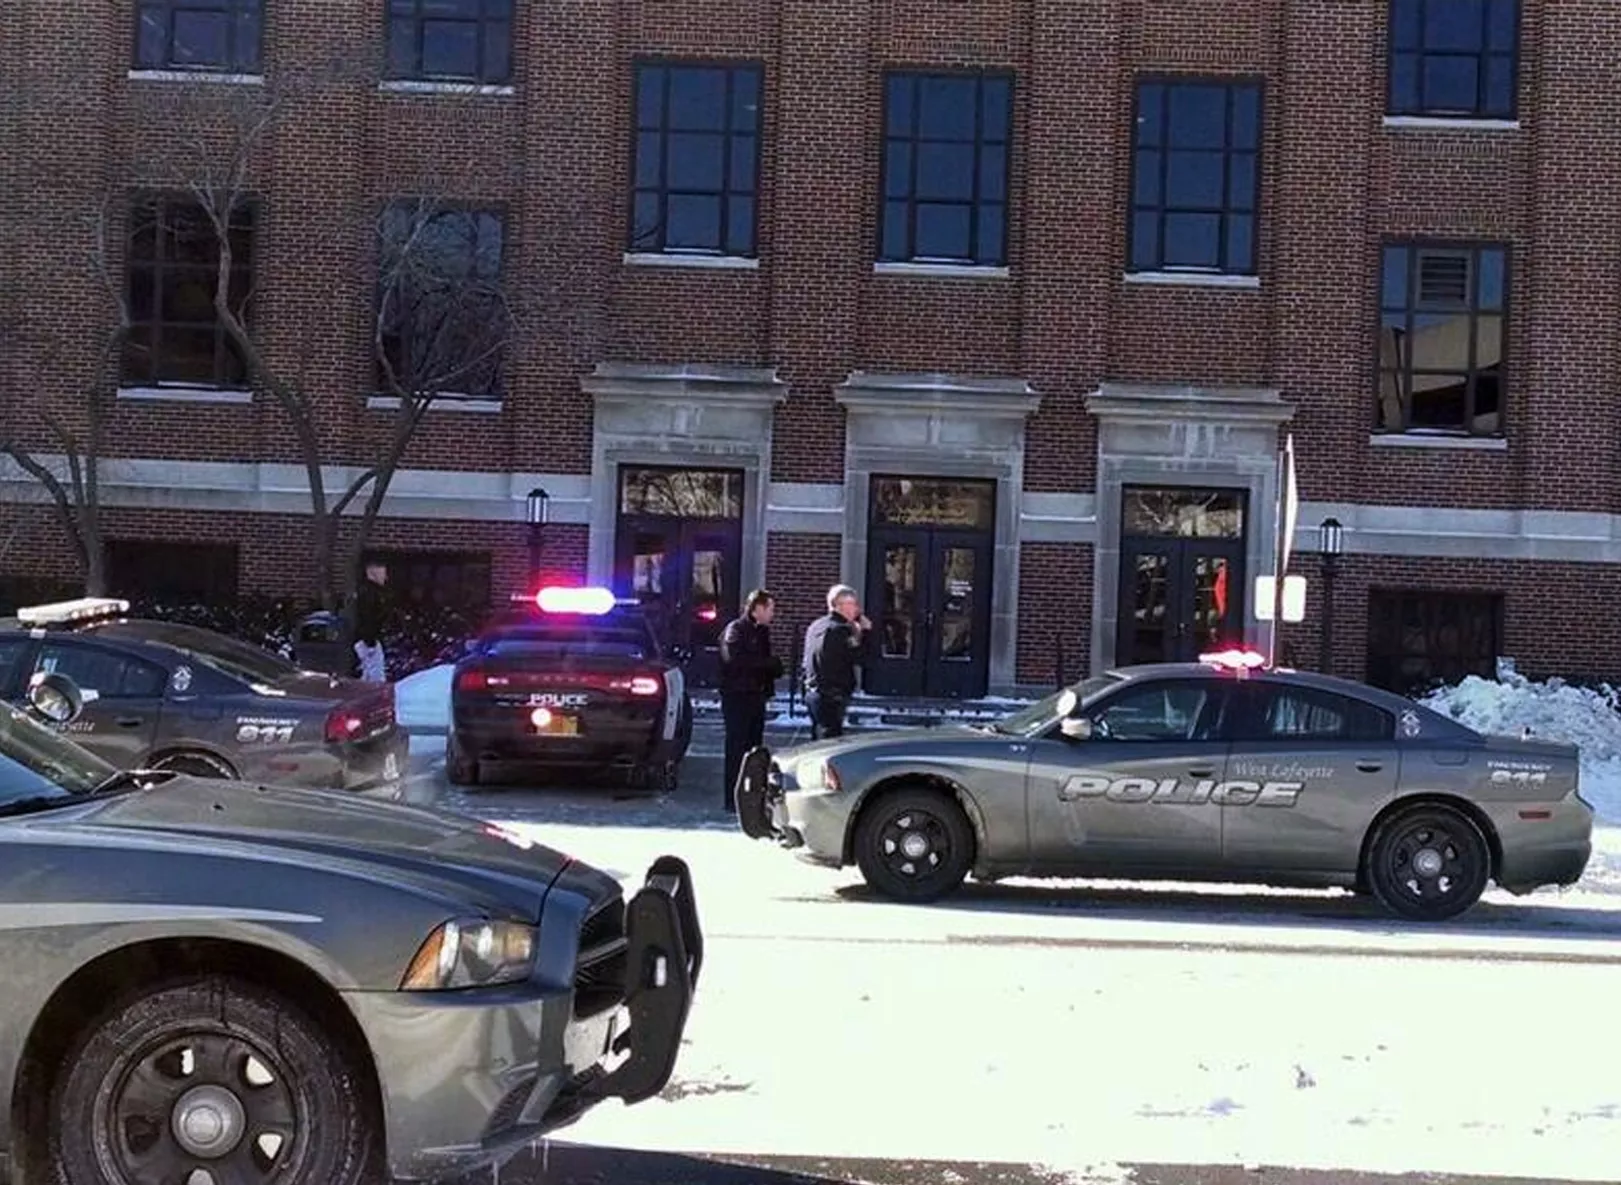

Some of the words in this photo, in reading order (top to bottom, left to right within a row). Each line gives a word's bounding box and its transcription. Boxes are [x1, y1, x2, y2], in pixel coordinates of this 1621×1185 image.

[529, 692, 588, 706] POLICE
[236, 725, 294, 744] 911
[1235, 762, 1267, 776] West
[1271, 761, 1335, 781] Lafayette
[1061, 776, 1302, 807] POLICE
